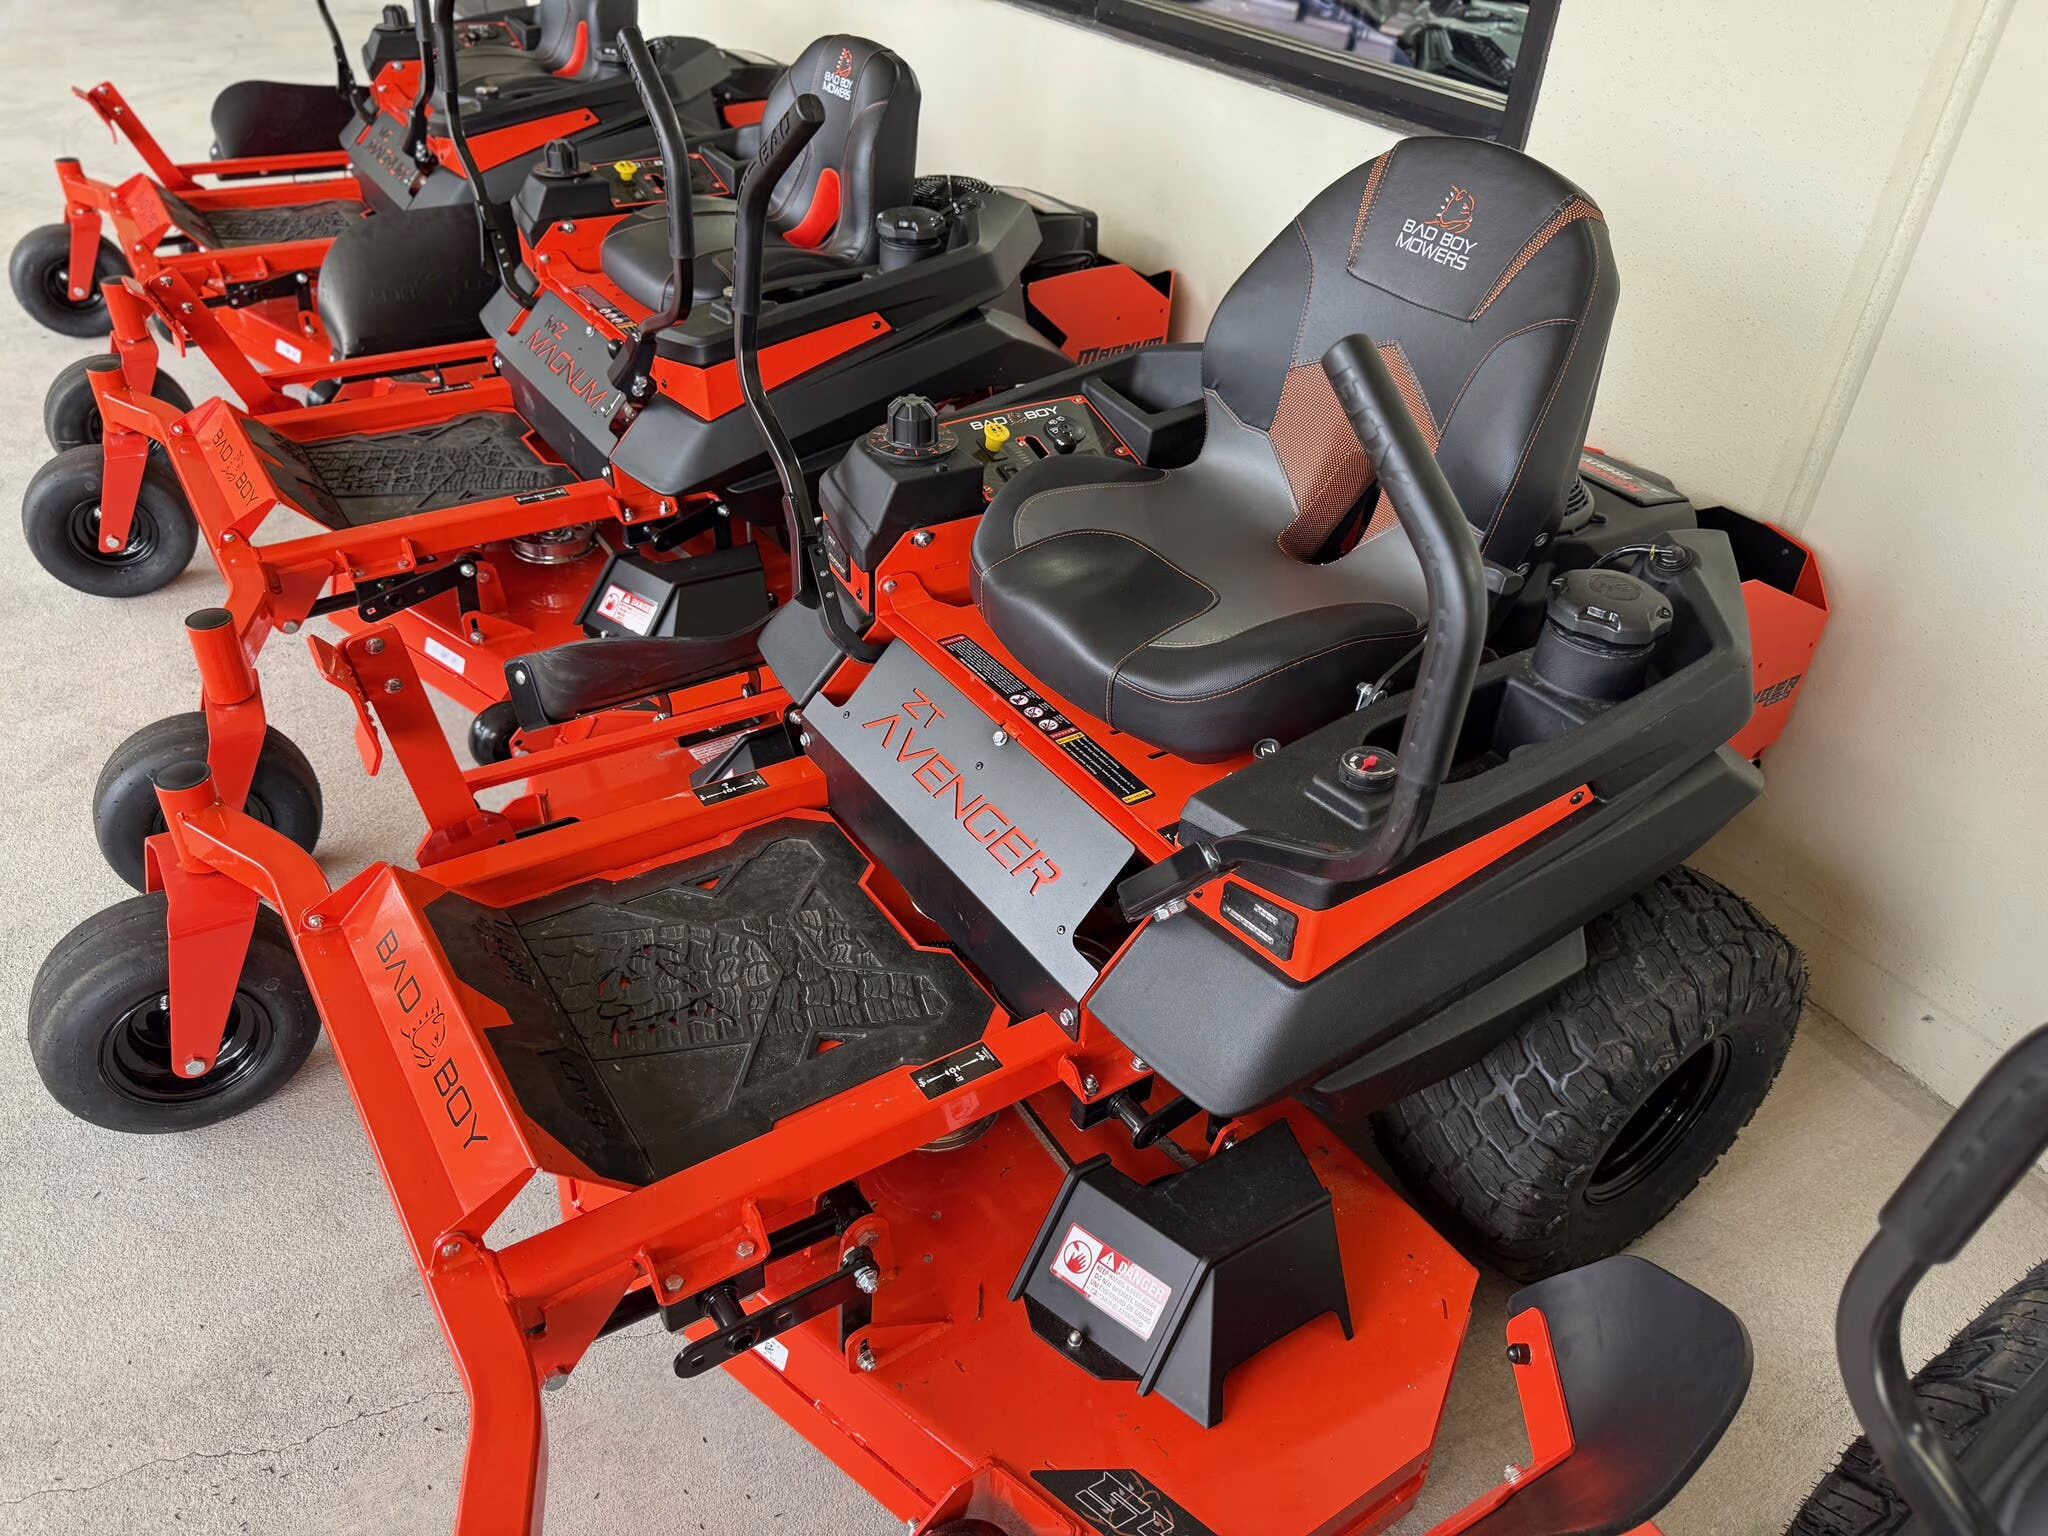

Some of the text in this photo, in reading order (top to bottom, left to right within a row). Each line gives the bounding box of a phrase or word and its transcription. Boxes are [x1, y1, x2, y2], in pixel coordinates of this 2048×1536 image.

[822, 80, 852, 101] MOWERS
[823, 71, 854, 90] BAD BOY
[1395, 231, 1470, 271] MOWERS
[1402, 218, 1478, 254] BAD BOY
[544, 314, 569, 341] MZ
[526, 328, 608, 409] MAGNUM
[970, 405, 1058, 431] BAD BOY
[212, 428, 259, 506] BAD BOY
[902, 687, 948, 728] ZT
[861, 713, 1064, 897] AVENGER
[375, 928, 489, 1150] BAD BOY
[1116, 1261, 1165, 1297] DANGER
